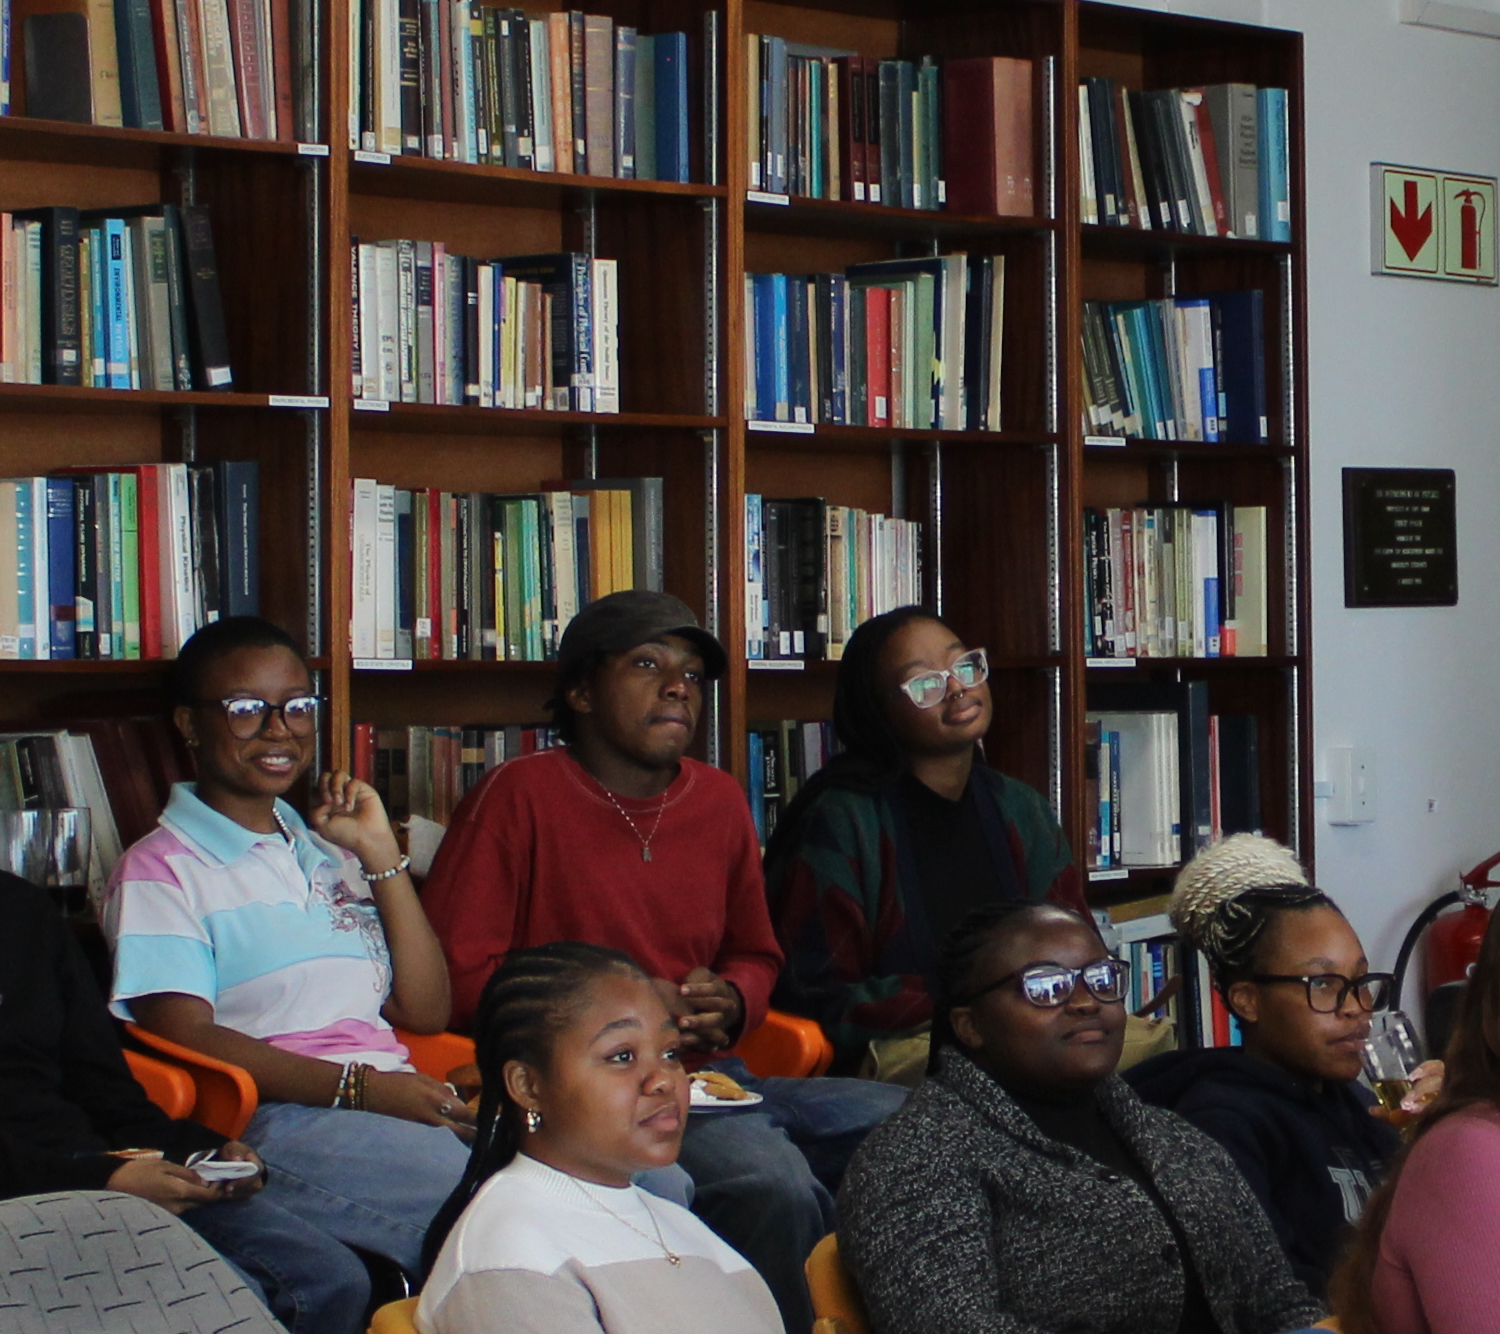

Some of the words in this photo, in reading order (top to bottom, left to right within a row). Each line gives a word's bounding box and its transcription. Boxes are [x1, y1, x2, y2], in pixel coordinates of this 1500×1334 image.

[64, 244, 76, 335] GEOPHYSICS
[350, 245, 358, 298] VALENCE
[575, 266, 589, 305] Principles
[113, 268, 122, 321] ENVIRONMENTAL
[578, 307, 589, 317] of
[114, 323, 124, 359] PHYSICS
[352, 303, 360, 349] THEORY
[576, 318, 590, 352] Physical
[179, 516, 189, 553] Physical
[183, 556, 191, 593] Kinetics
